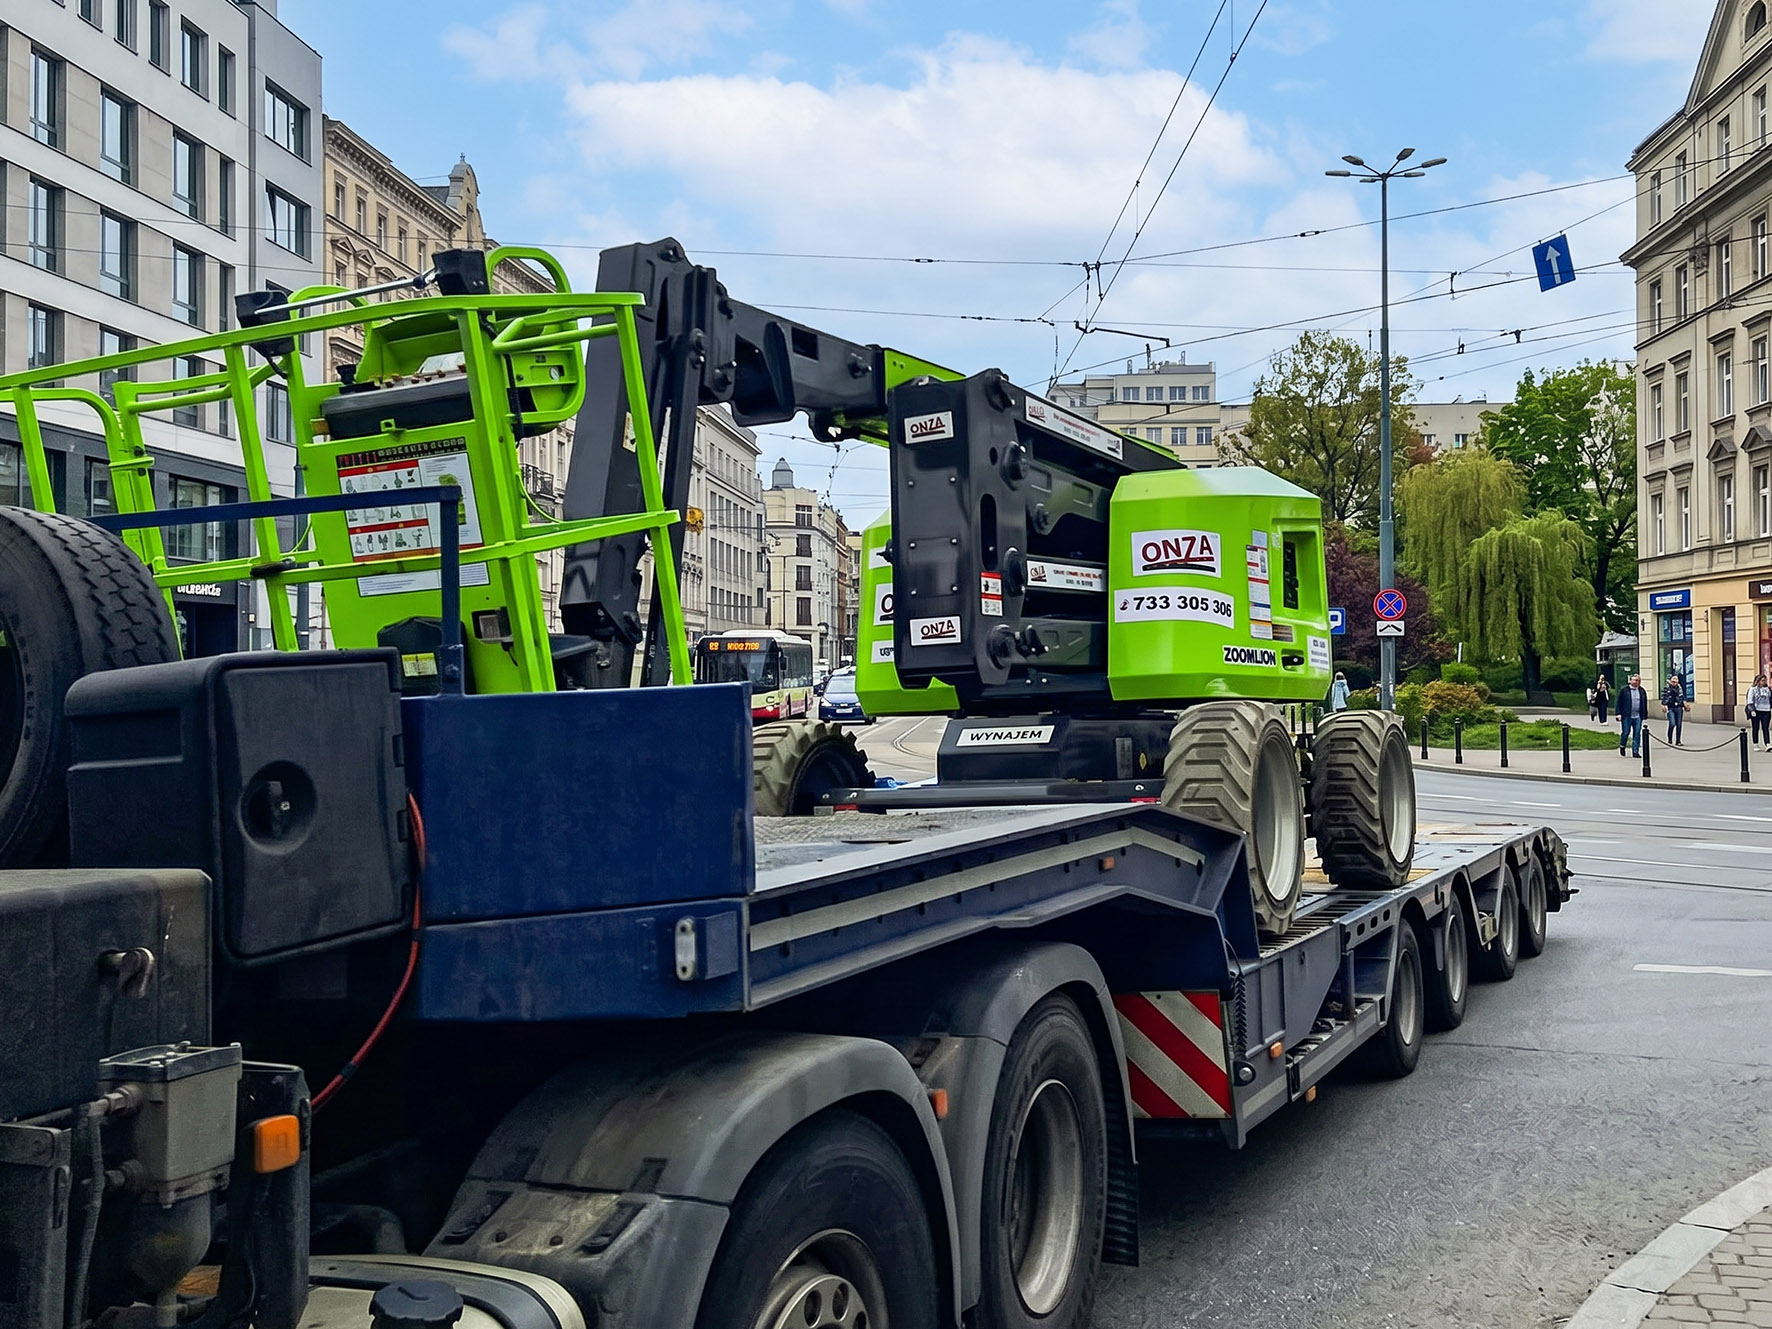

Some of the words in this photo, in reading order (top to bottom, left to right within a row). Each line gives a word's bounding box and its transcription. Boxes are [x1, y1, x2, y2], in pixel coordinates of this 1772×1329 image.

[910, 416, 945, 434] ONZA
[1141, 535, 1215, 563] ONZA
[1133, 595, 1171, 611] 733
[1177, 595, 1209, 611] 305
[1213, 599, 1232, 618] 306
[921, 619, 955, 636] ONZA
[970, 730, 1042, 742] WYNAJEM
